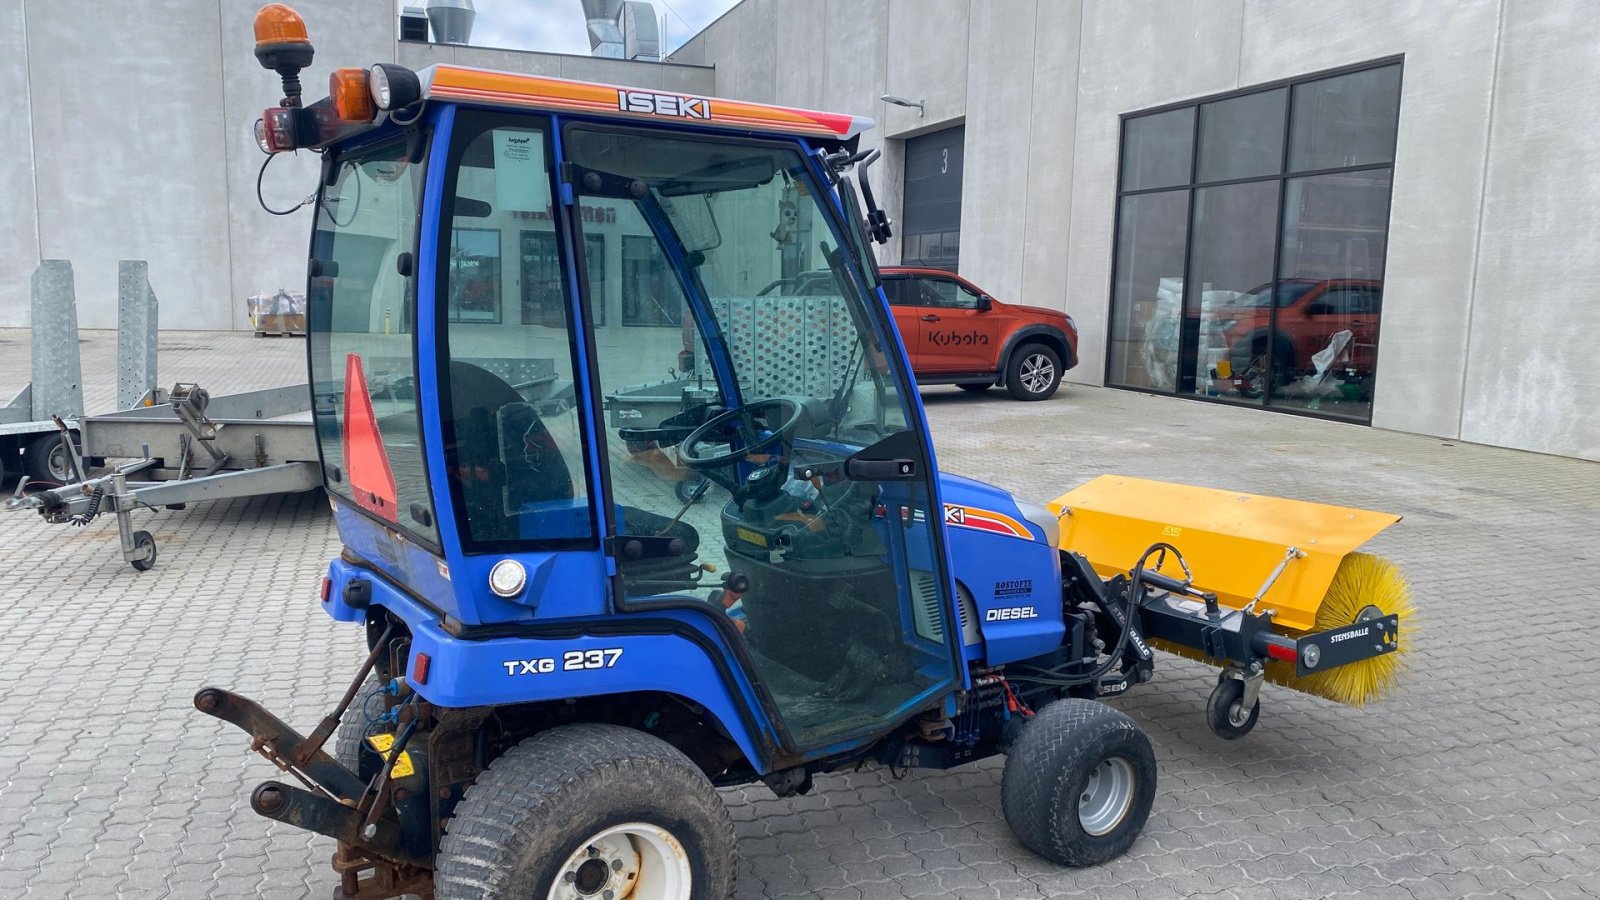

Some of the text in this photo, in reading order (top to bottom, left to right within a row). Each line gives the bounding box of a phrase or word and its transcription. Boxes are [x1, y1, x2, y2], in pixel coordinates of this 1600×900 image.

[617, 89, 711, 120] ISEKI
[941, 147, 948, 174] 3
[928, 330, 989, 346] Kubota
[985, 606, 1038, 622] DIESEL
[1330, 627, 1369, 644] STENSBALLE
[503, 648, 624, 676] TXG 237
